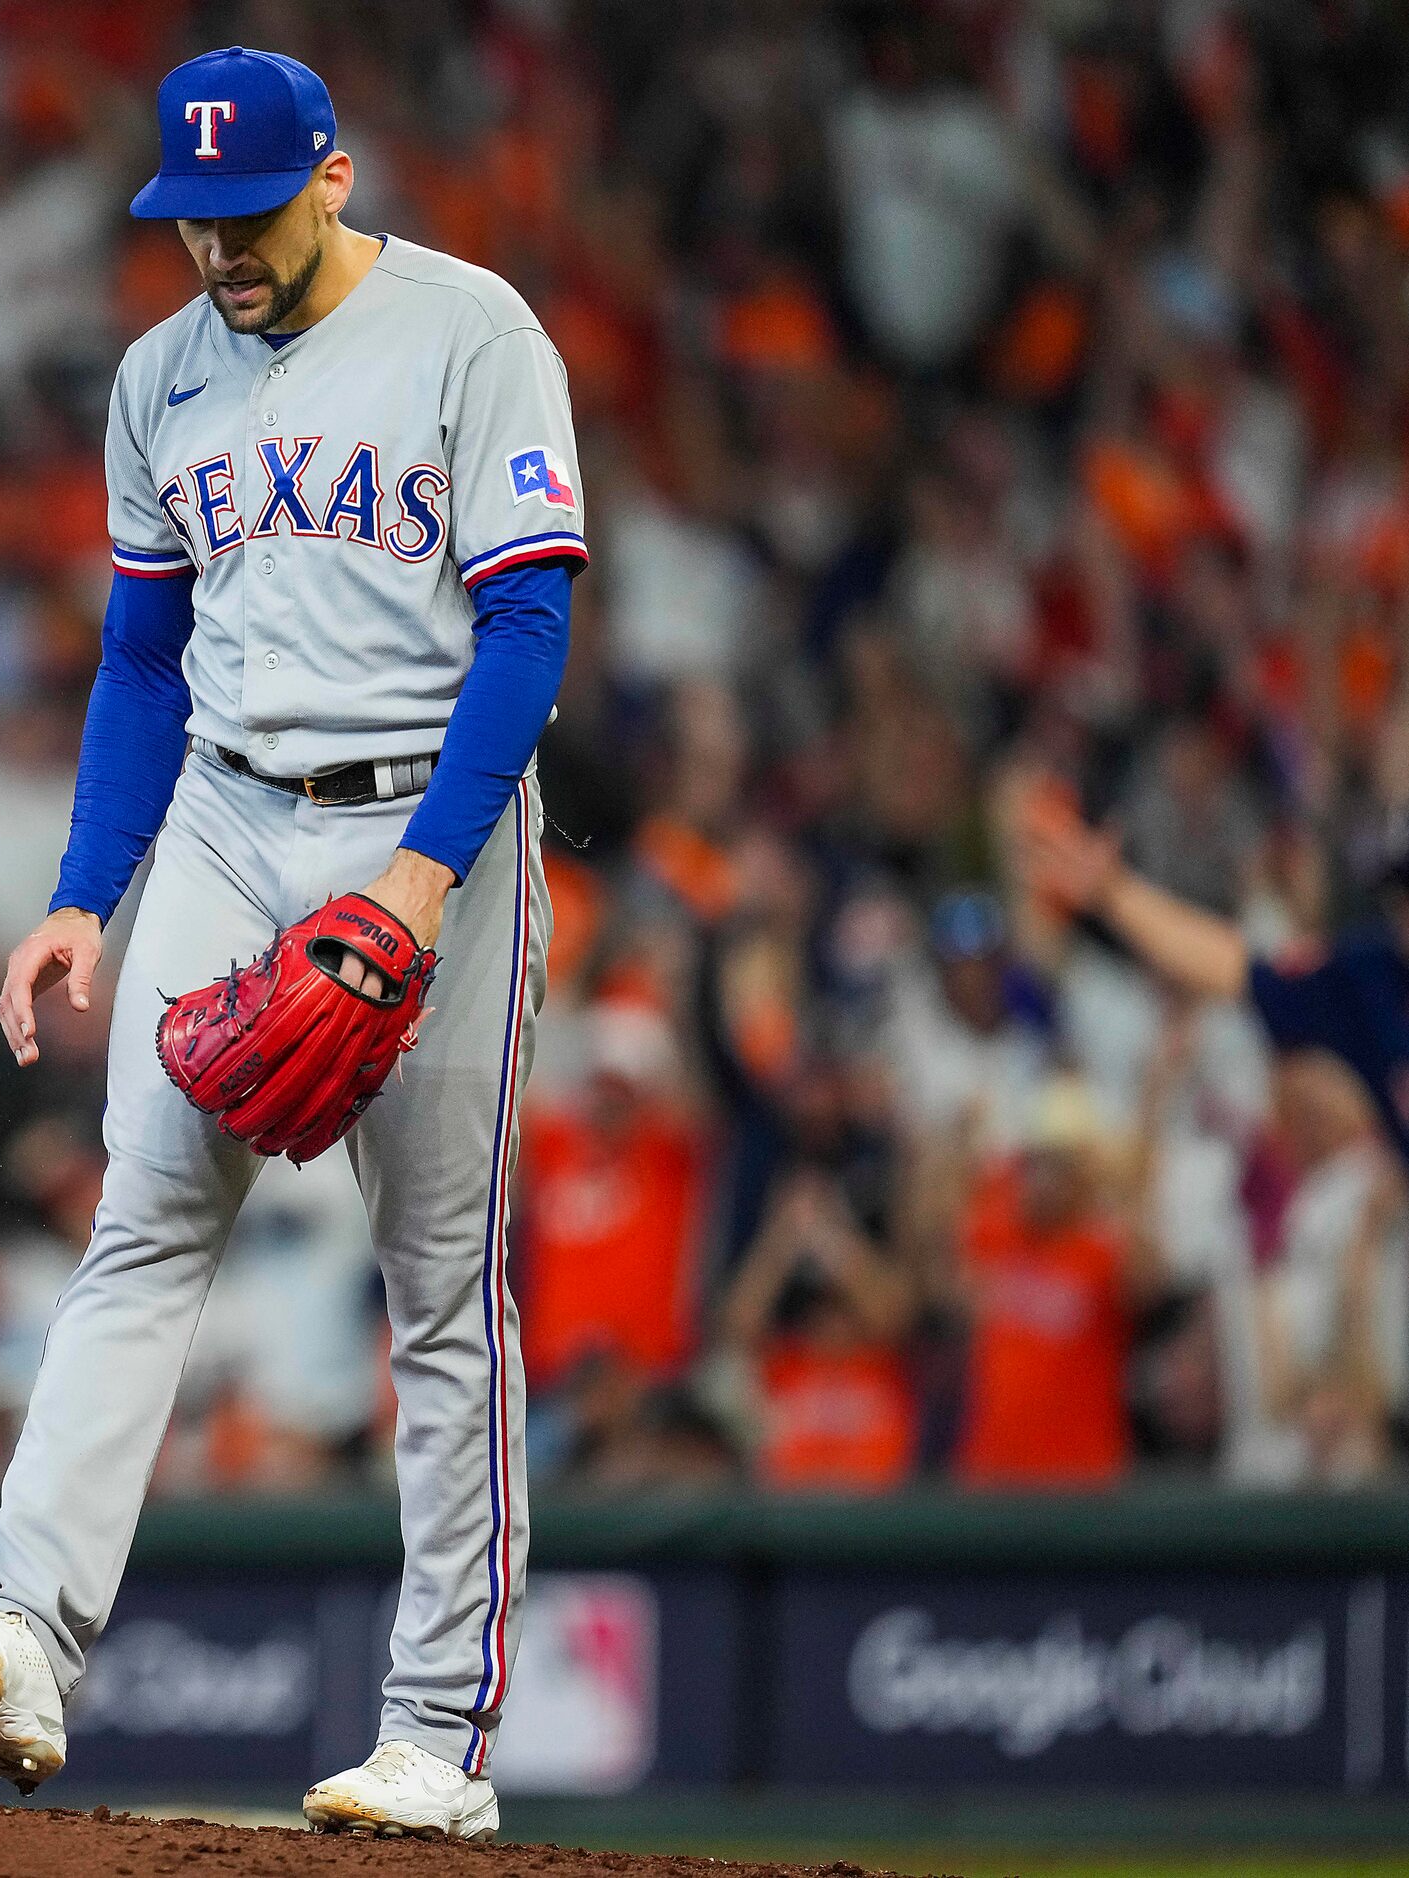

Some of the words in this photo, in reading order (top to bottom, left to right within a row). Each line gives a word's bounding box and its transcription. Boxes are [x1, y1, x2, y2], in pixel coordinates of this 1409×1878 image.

[185, 101, 236, 160] T
[157, 436, 452, 579] TEXAS
[335, 911, 399, 958] Wilson
[219, 1052, 264, 1095] A2000
